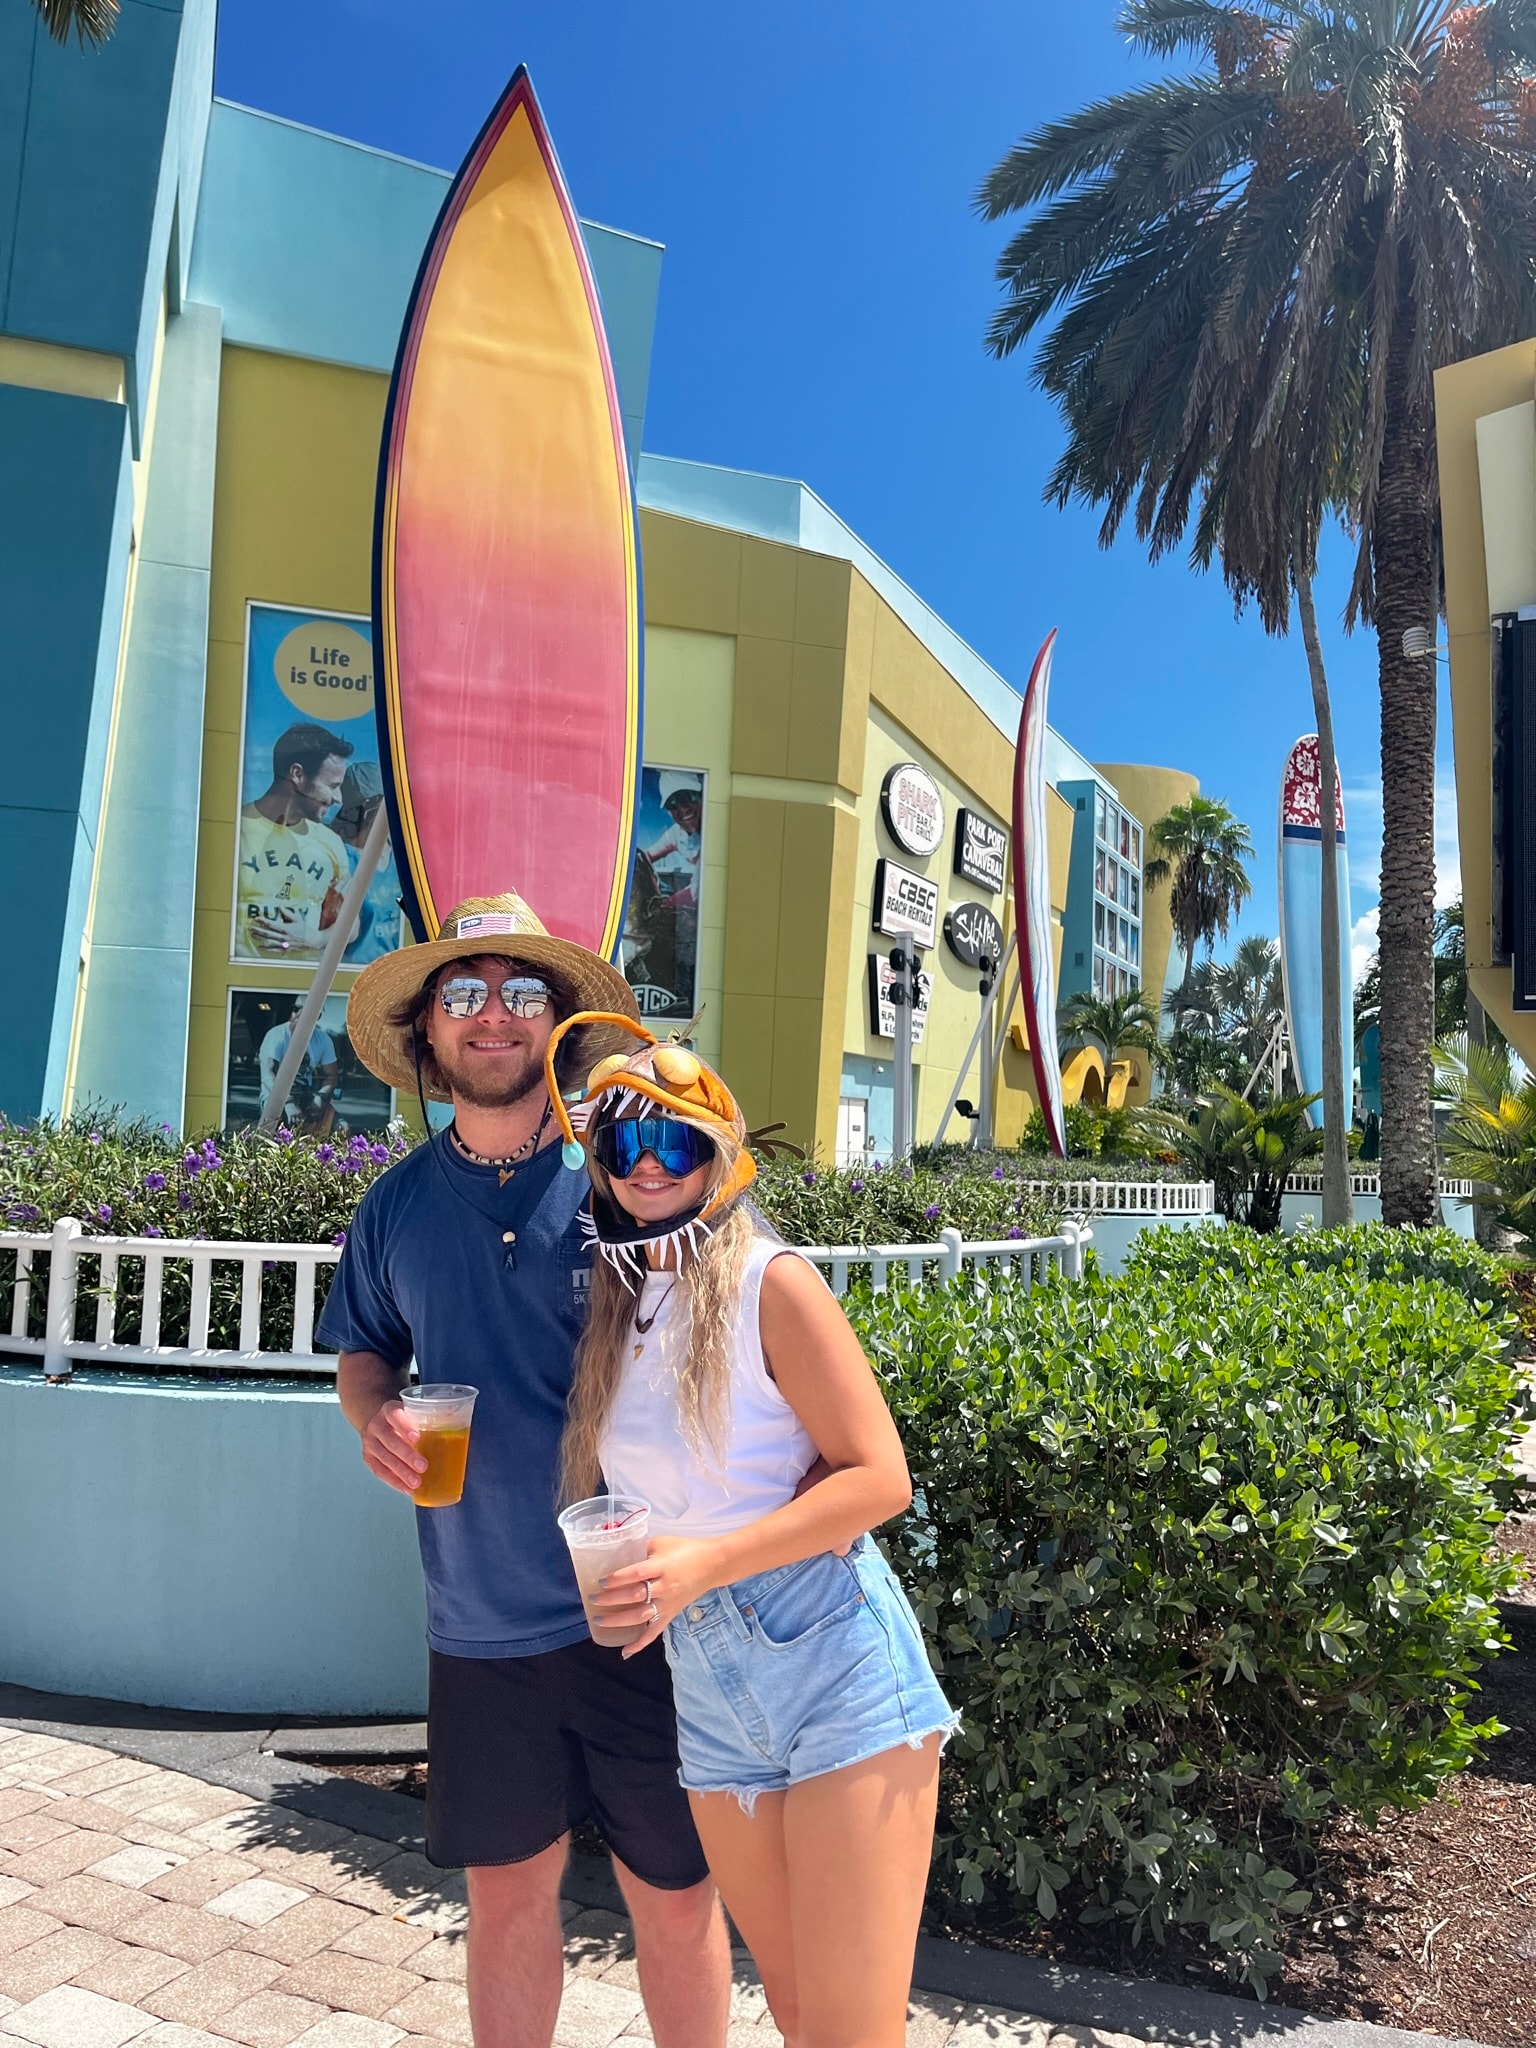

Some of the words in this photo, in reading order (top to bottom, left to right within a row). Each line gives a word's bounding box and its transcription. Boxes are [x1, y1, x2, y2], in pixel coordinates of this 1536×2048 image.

[310, 646, 350, 667] Life
[290, 666, 307, 685] is
[313, 669, 367, 692] Good
[899, 777, 937, 820] SHARK
[897, 801, 917, 832] PIT
[967, 813, 987, 841] PARK
[987, 827, 1005, 852] PORT
[241, 849, 324, 881] YEAH
[963, 842, 1003, 881] CANAVERAL
[886, 895, 908, 917] BEACH
[907, 905, 933, 927] RENTALS
[898, 878, 936, 912] CBSC
